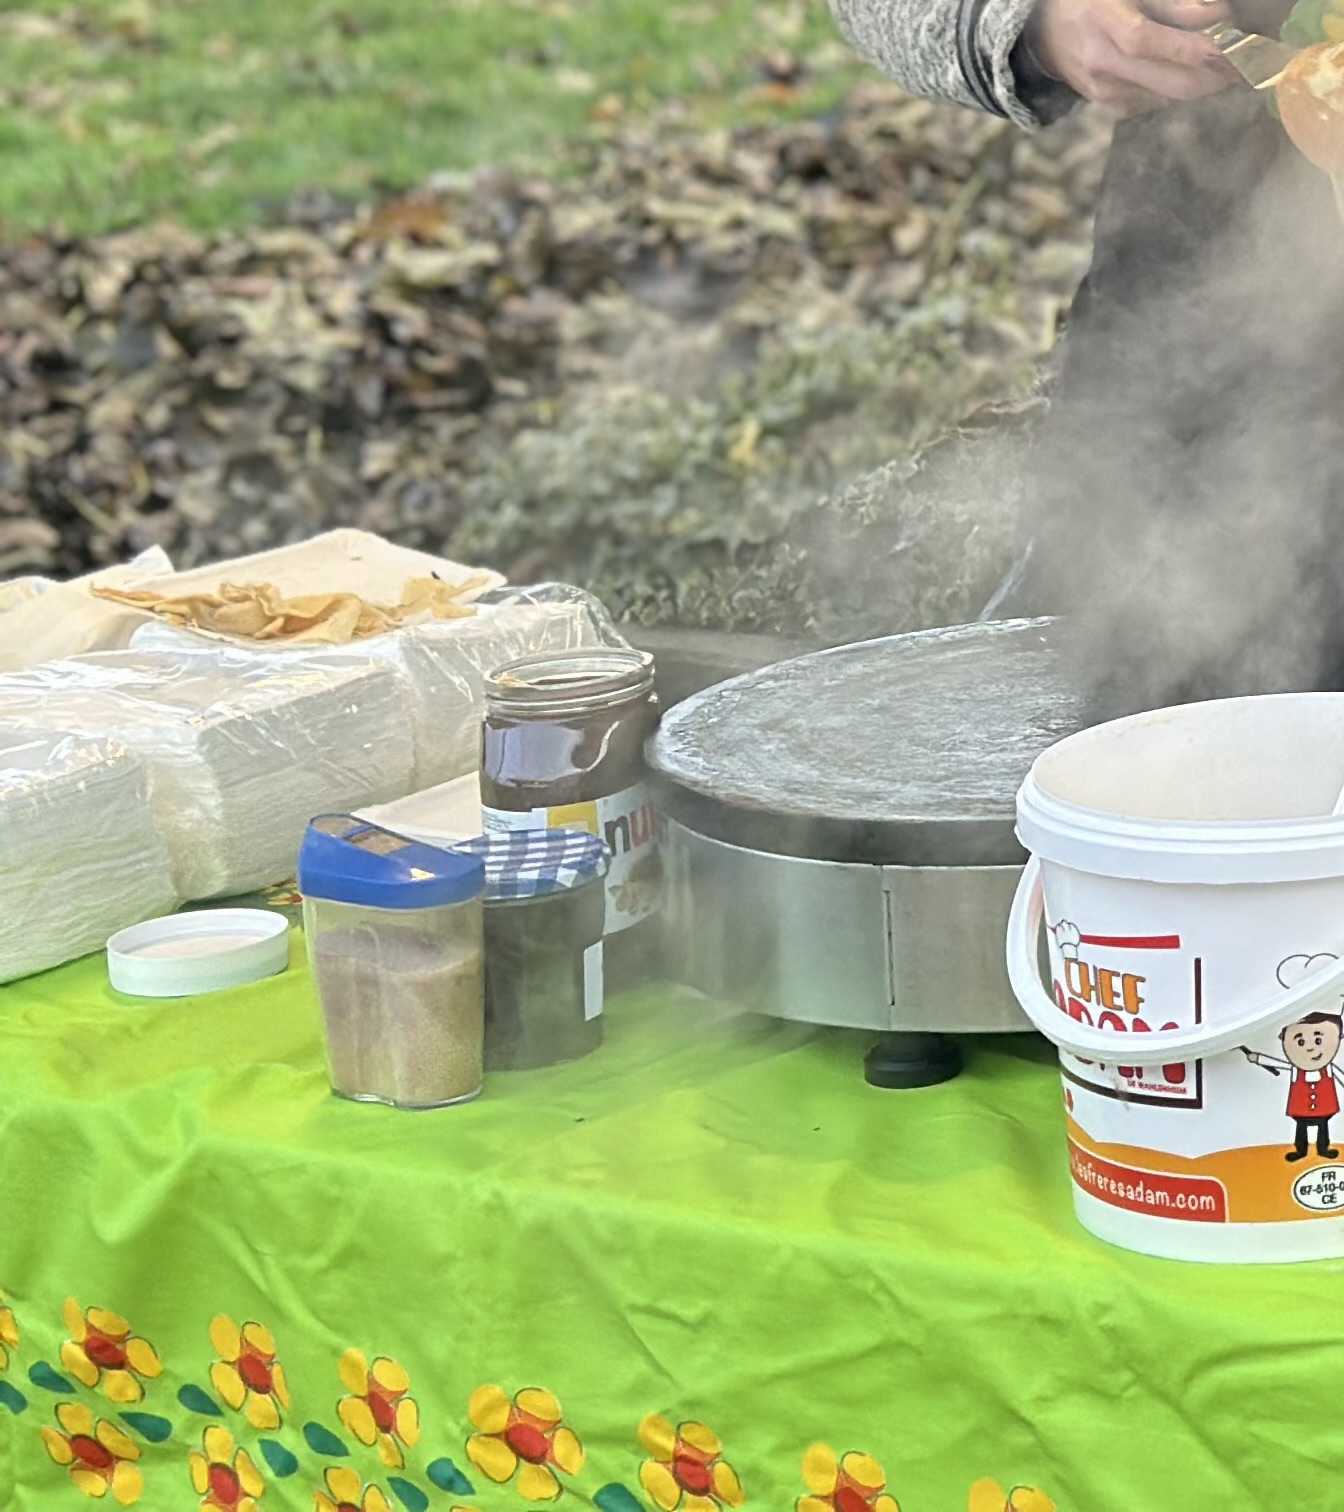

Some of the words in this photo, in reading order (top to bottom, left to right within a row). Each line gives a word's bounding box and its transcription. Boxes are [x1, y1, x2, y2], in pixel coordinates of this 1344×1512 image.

[1065, 958, 1146, 1015] CHEF
[1321, 1171, 1336, 1182] FR
[1321, 1193, 1337, 1204] CE
